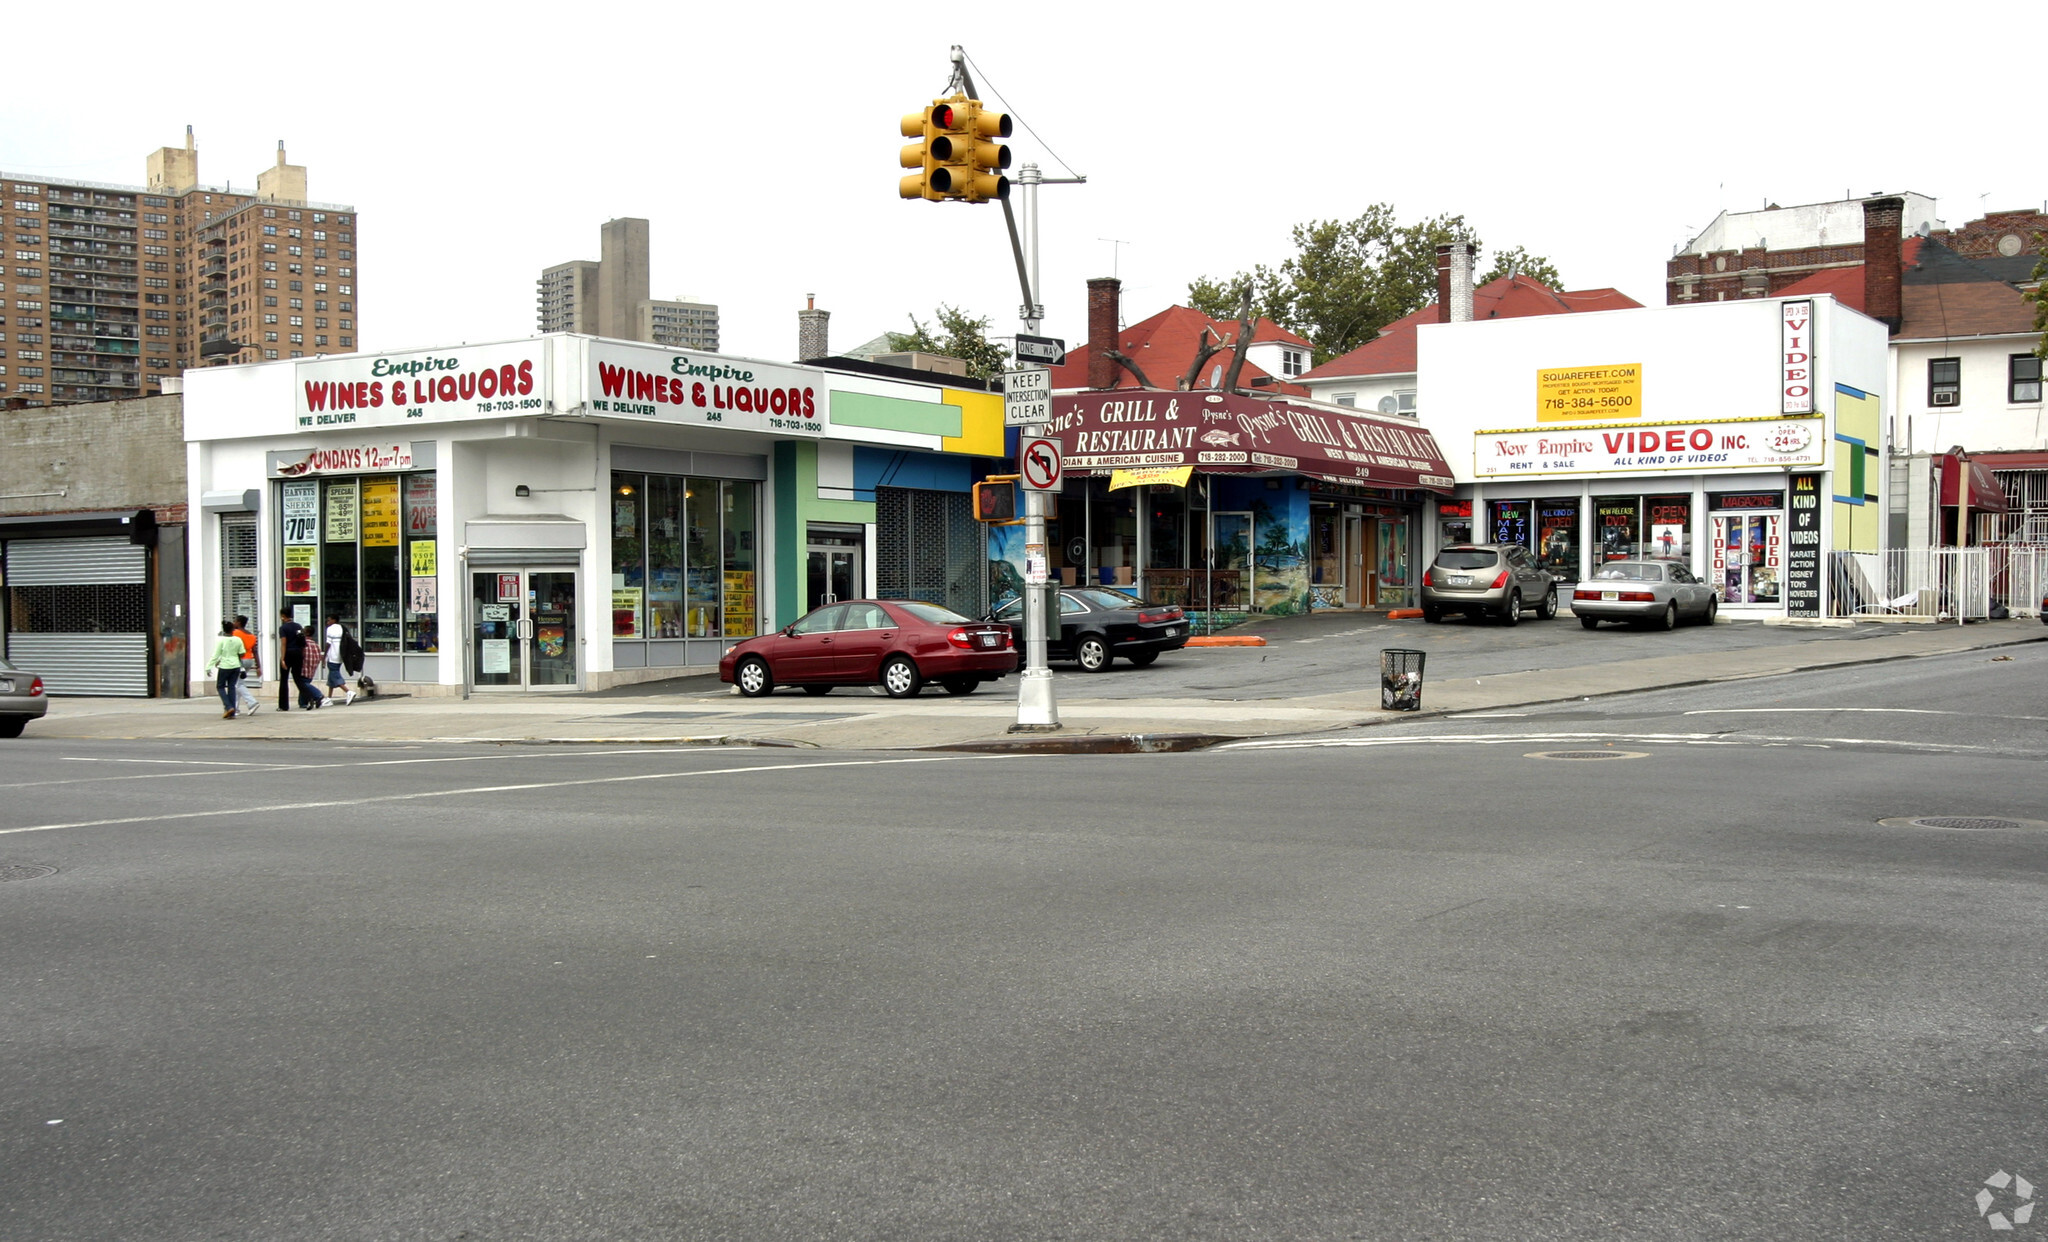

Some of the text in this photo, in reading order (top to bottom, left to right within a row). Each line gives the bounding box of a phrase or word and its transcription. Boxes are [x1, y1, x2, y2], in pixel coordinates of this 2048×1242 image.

[1020, 343, 1058, 357] ONE WAY
[1785, 319, 1809, 397] VIDEO
[371, 357, 460, 377] Empire
[671, 356, 754, 383] Empire
[1012, 374, 1041, 388] KEEP
[1542, 369, 1635, 382] SQUAREFEET.COM
[304, 359, 533, 412] WINES & LIQUORS
[599, 361, 815, 419] WINES & LIQUORS
[1007, 389, 1048, 403] INTERSECTION
[1545, 395, 1633, 409] 718-384-5600
[406, 408, 423, 418] 245
[476, 399, 542, 413] 718-703-1500
[593, 400, 656, 415] WE DELIVER
[1011, 405, 1045, 419] CLEAR
[1100, 398, 1179, 424] GRILL &
[299, 413, 356, 427] WE DELIVER
[707, 412, 722, 422] 245
[1041, 403, 1084, 436] ysne's
[1202, 408, 1232, 425] Pysne's
[769, 418, 822, 432] 718-703-1500
[1075, 426, 1197, 453] RESTAURANT
[1236, 404, 1444, 462] Pysne's GRILL & RESTAURANT
[1495, 438, 1593, 457] New Empire
[1602, 428, 1750, 455] VIDEO INC.
[1774, 436, 1789, 447] 24
[1063, 453, 1179, 467] DIAN & AMERICAN CUISINE
[1201, 453, 1245, 461] 718-282-2000
[1323, 447, 1345, 460] WEST
[1344, 450, 1369, 463] INDIAN
[1376, 455, 1410, 469] AMERICAN
[1613, 453, 1728, 466] ALL KIND OF VIDEOS
[1355, 466, 1370, 477] 249
[1510, 460, 1575, 470] RENT & SALE
[1796, 477, 1814, 491] ALL
[284, 488, 315, 497] HARVEYS
[330, 488, 354, 496] SPECIAL
[285, 501, 315, 510] SHERRY
[1721, 495, 1774, 508] MAGAZINE
[1793, 495, 1817, 509] KIND
[1501, 511, 1519, 519] NEW
[1599, 507, 1634, 516] NEW RELEASE
[1651, 505, 1687, 517] OPEN
[1545, 517, 1572, 528] VIDEO
[1605, 515, 1627, 526] DVD
[1798, 513, 1811, 527] OF
[1713, 518, 1724, 569] VIDEO
[1768, 515, 1780, 567] VIDEO
[1791, 530, 1819, 545] VIDEOS
[1790, 550, 1816, 558] KARATE
[1790, 560, 1815, 568] ACTION
[1790, 570, 1814, 578] DISNEY
[1790, 580, 1807, 588] TOYS
[1789, 590, 1818, 598] NOVELTIES
[1789, 600, 1805, 608] DVD
[1789, 610, 1819, 618] EUROPEAN
